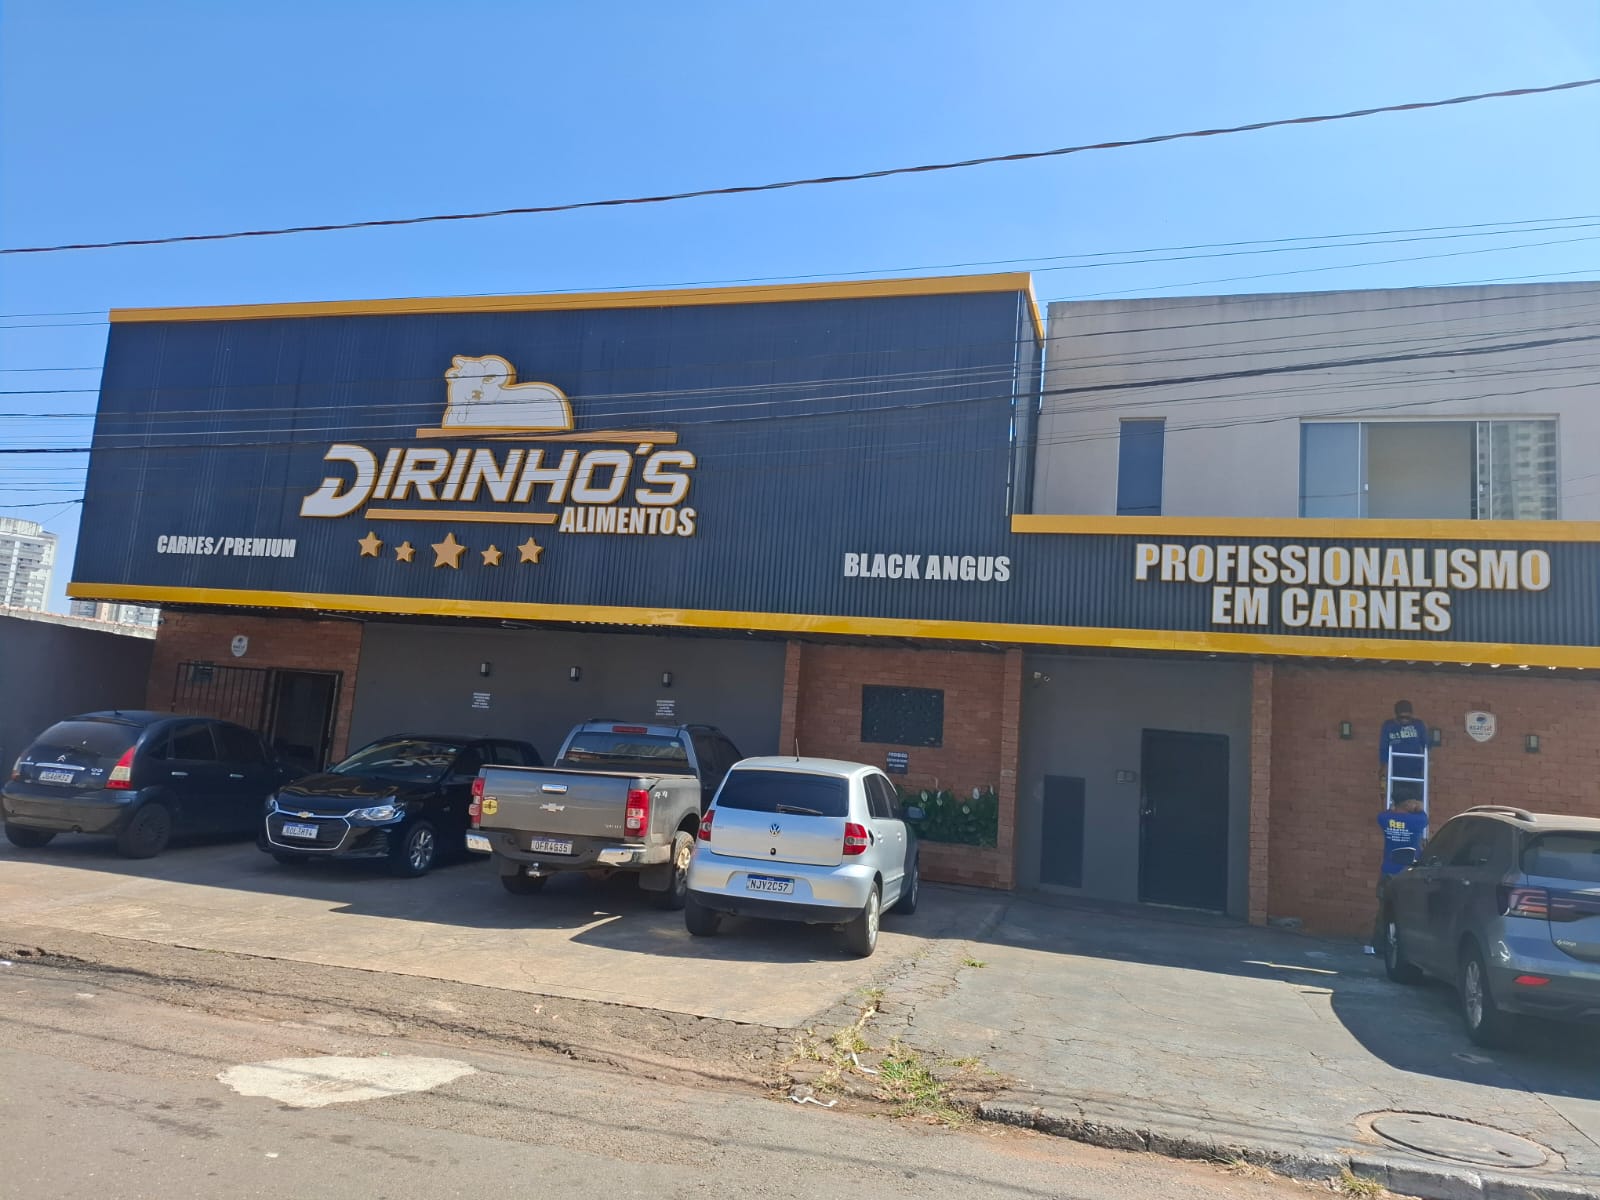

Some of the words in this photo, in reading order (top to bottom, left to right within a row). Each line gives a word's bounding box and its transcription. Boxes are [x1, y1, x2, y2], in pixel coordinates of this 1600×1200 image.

[300, 443, 698, 518] DIRINHO'S
[559, 506, 697, 537] ALIMENTOS
[157, 535, 297, 558] CARNES/PREMIUM
[844, 552, 921, 579] BLACK
[925, 555, 1010, 582] ANGUS
[1135, 543, 1552, 592] PROFISSIONALISMO
[1211, 585, 1270, 626] EM
[1281, 588, 1453, 632] CARNES
